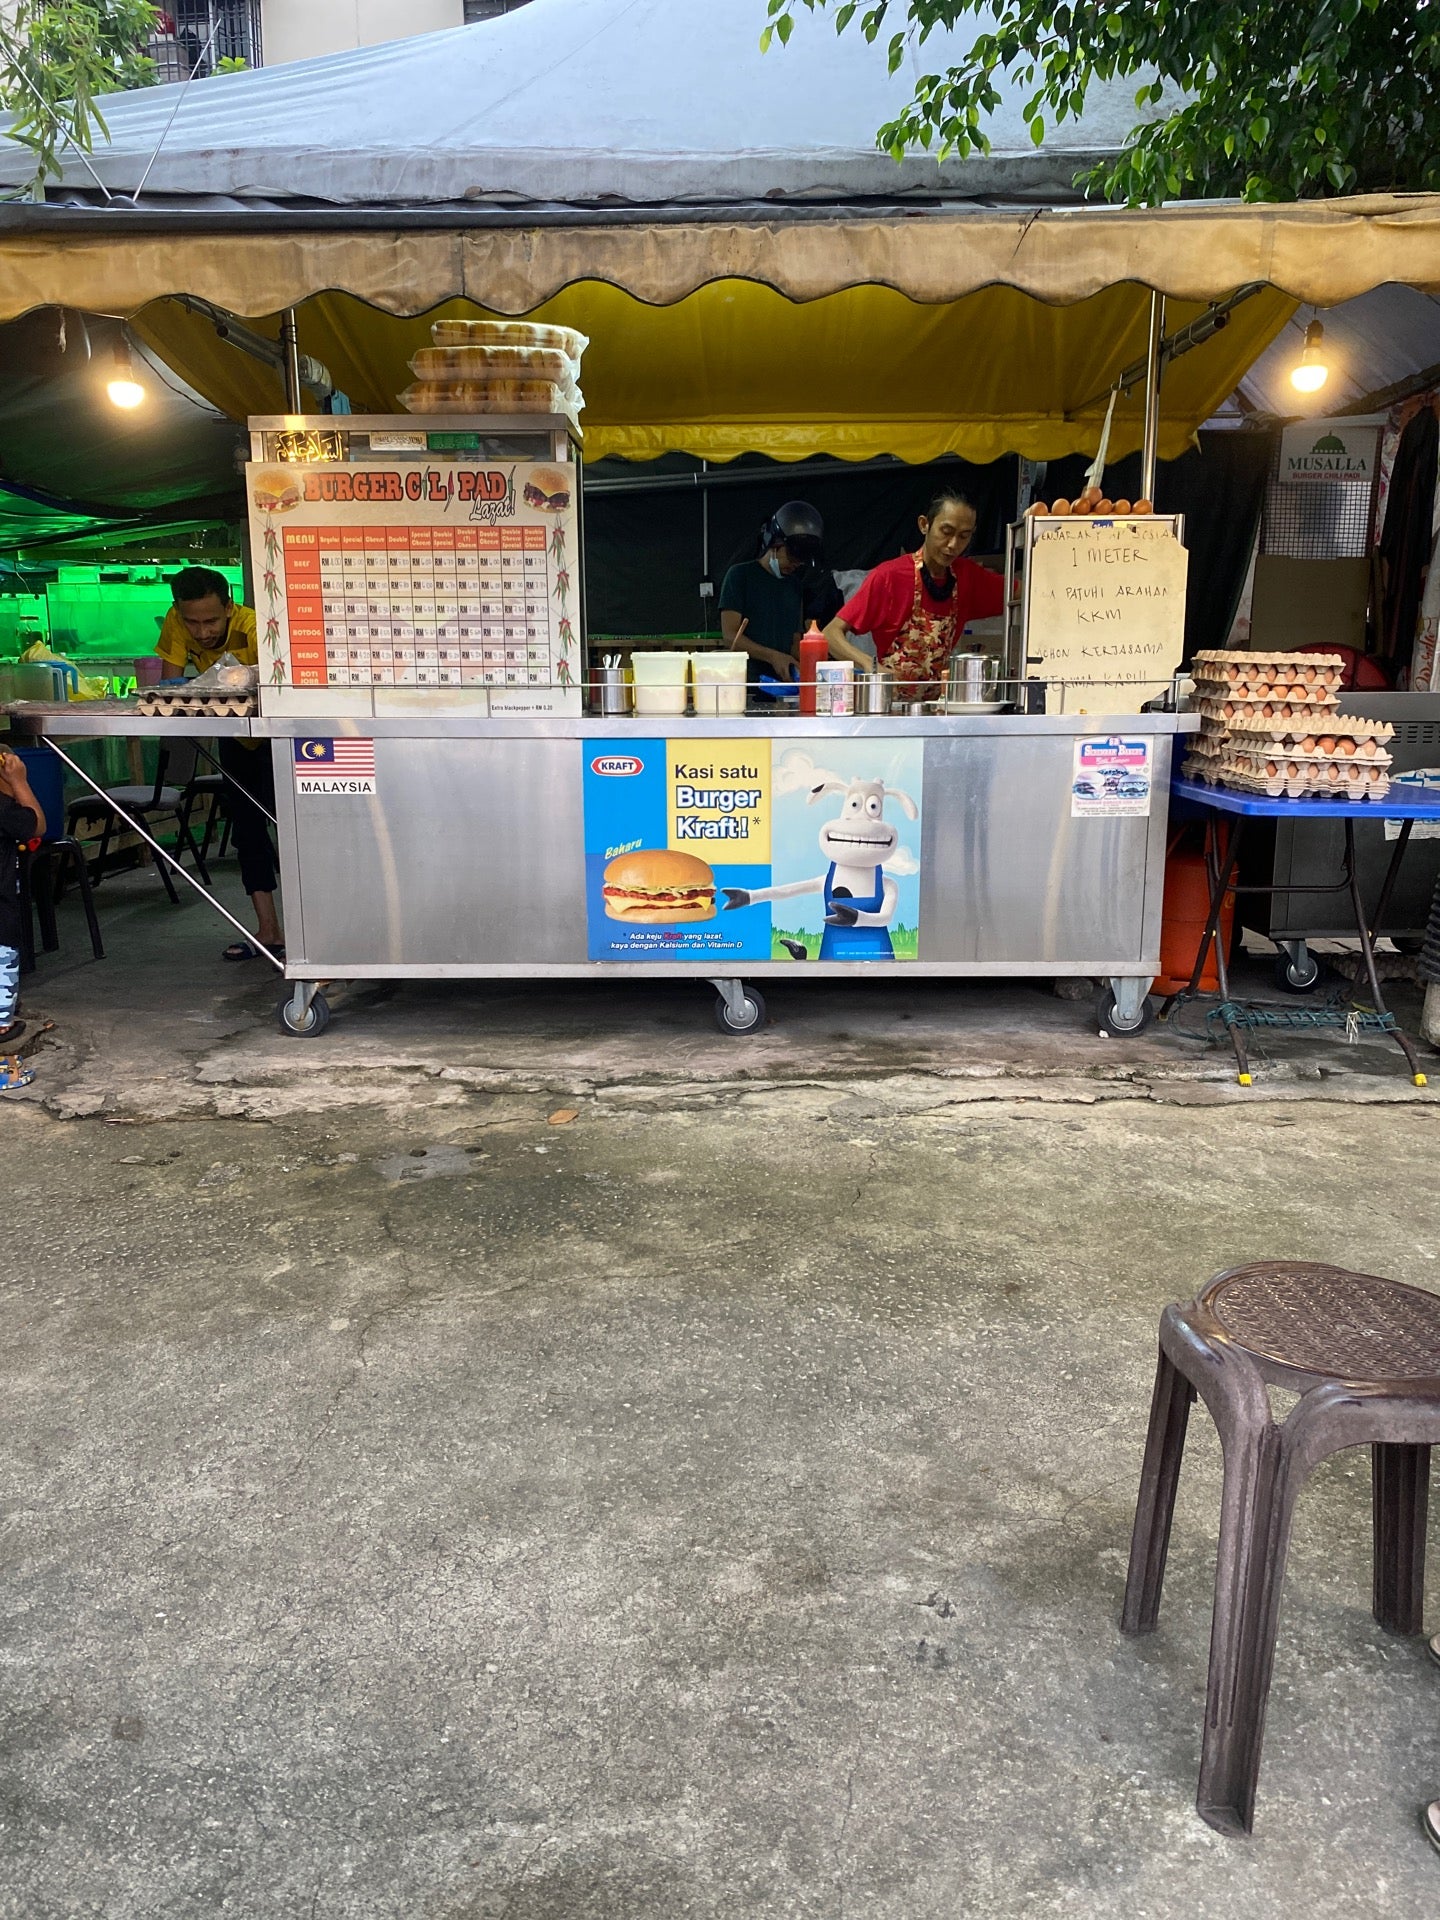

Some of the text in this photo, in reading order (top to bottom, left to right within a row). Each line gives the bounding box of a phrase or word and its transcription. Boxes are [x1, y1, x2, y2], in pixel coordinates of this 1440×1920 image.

[1287, 457, 1367, 471] MUSALLA
[303, 472, 403, 501] BURGER
[286, 535, 315, 544] MENU
[1088, 548, 1148, 564] METER
[322, 558, 330, 566] RM
[344, 558, 352, 566] RM
[367, 558, 375, 566] RM
[389, 558, 397, 566] RM
[412, 558, 420, 566] RM
[434, 558, 442, 566] RM
[457, 558, 465, 566] RM
[480, 558, 488, 566] RM
[502, 558, 510, 566] RM
[525, 558, 533, 566] RM
[323, 581, 331, 589] RM
[346, 581, 354, 589] RM
[368, 581, 376, 589] RM
[391, 581, 399, 589] RM
[413, 581, 421, 589] RM
[436, 581, 444, 589] RM
[458, 581, 466, 589] RM
[481, 581, 489, 589] RM
[503, 581, 511, 589] RM
[526, 581, 534, 589] RM
[1066, 586, 1104, 600] PATUHI
[1115, 585, 1168, 599] ARAHAN
[324, 605, 332, 613] RM
[347, 605, 355, 613] RM
[369, 605, 377, 613] RM
[392, 605, 400, 613] RM
[415, 605, 423, 613] RM
[437, 605, 445, 613] RM
[460, 605, 468, 613] RM
[482, 605, 490, 613] RM
[505, 605, 513, 613] RM
[527, 605, 535, 613] RM
[1077, 608, 1122, 624] KKM
[326, 628, 334, 636] RM
[349, 628, 357, 636] RM
[370, 628, 378, 636] RM
[394, 628, 402, 636] RM
[416, 628, 424, 636] RM
[438, 628, 446, 636] RM
[461, 628, 469, 636] RM
[483, 628, 491, 636] RM
[506, 628, 514, 636] RM
[528, 628, 536, 636] RM
[327, 651, 335, 659] RM
[350, 651, 358, 659] RM
[372, 651, 380, 659] RM
[395, 651, 403, 659] RM
[417, 651, 425, 659] RM
[439, 651, 447, 659] RM
[462, 651, 470, 659] RM
[484, 651, 492, 659] RM
[507, 651, 515, 659] RM
[528, 651, 536, 659] RM
[329, 673, 337, 681] RM
[352, 673, 360, 681] RM
[373, 673, 381, 681] RM
[418, 673, 426, 681] RM
[441, 673, 449, 681] RM
[485, 673, 493, 681] RM
[508, 673, 516, 681] RM
[530, 673, 538, 681] RM
[601, 761, 634, 770] KRAFT
[675, 764, 758, 779] Kasi satu
[301, 782, 372, 793] MALAYSIA
[676, 785, 762, 813] Burger
[605, 837, 643, 860] Baharu
[646, 933, 662, 941] keju
[663, 932, 683, 940] Kraft
[683, 934, 702, 942] yang
[611, 942, 628, 950] kaya
[630, 942, 658, 950] dengan
